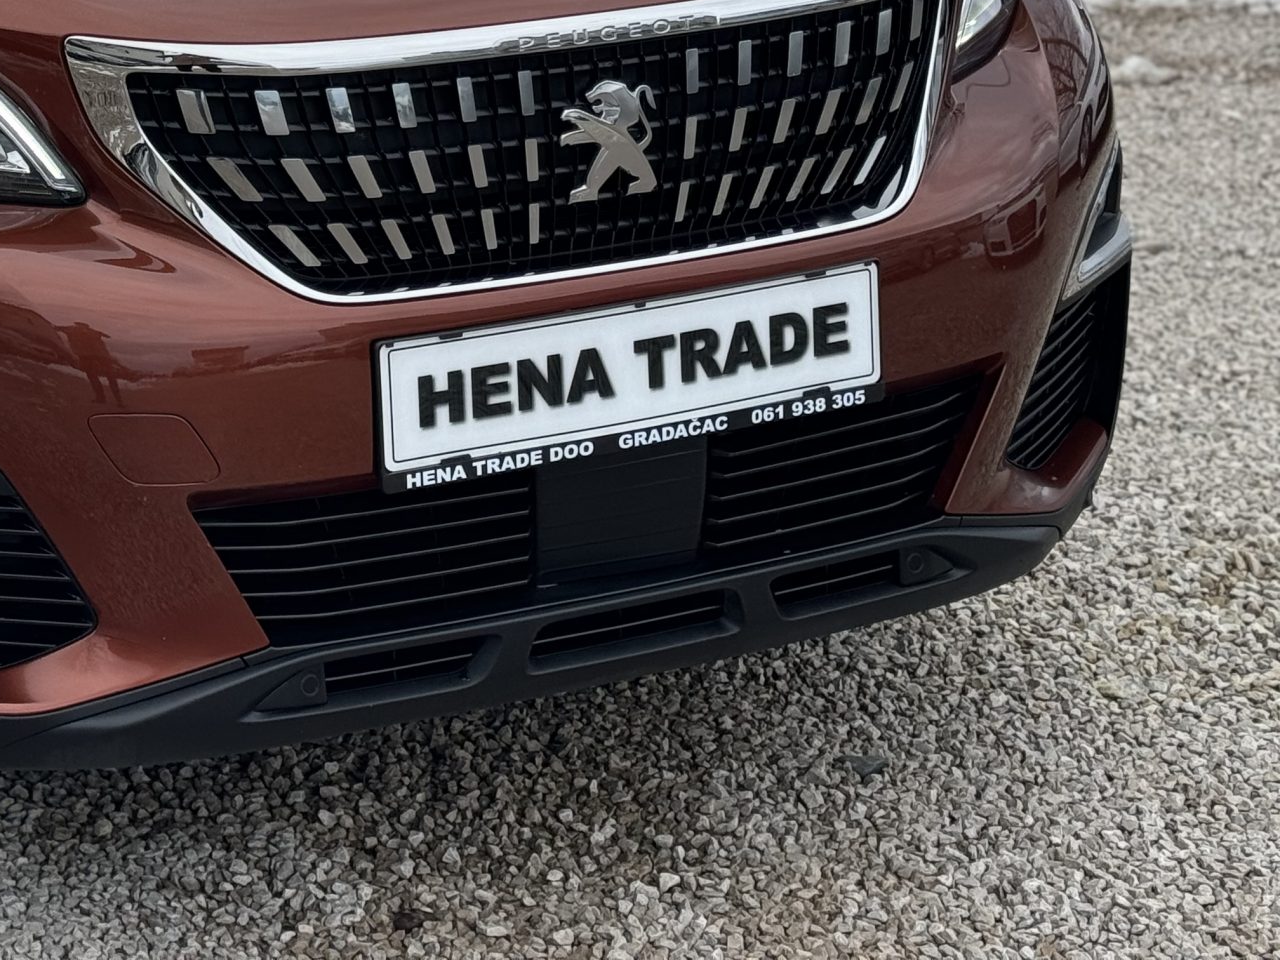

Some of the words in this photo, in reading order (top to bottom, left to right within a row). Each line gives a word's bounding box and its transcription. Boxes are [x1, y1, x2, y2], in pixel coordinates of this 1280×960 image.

[518, 14, 696, 50] PEUGEOT
[418, 348, 615, 428] HENA
[634, 302, 851, 389] TRADE
[406, 464, 467, 490] HENA
[472, 451, 544, 476] TRADE
[550, 441, 595, 463] DOO
[618, 417, 729, 450] GRADAČAC
[751, 404, 785, 425] 061
[792, 397, 827, 417] 938
[831, 389, 866, 410] 305
